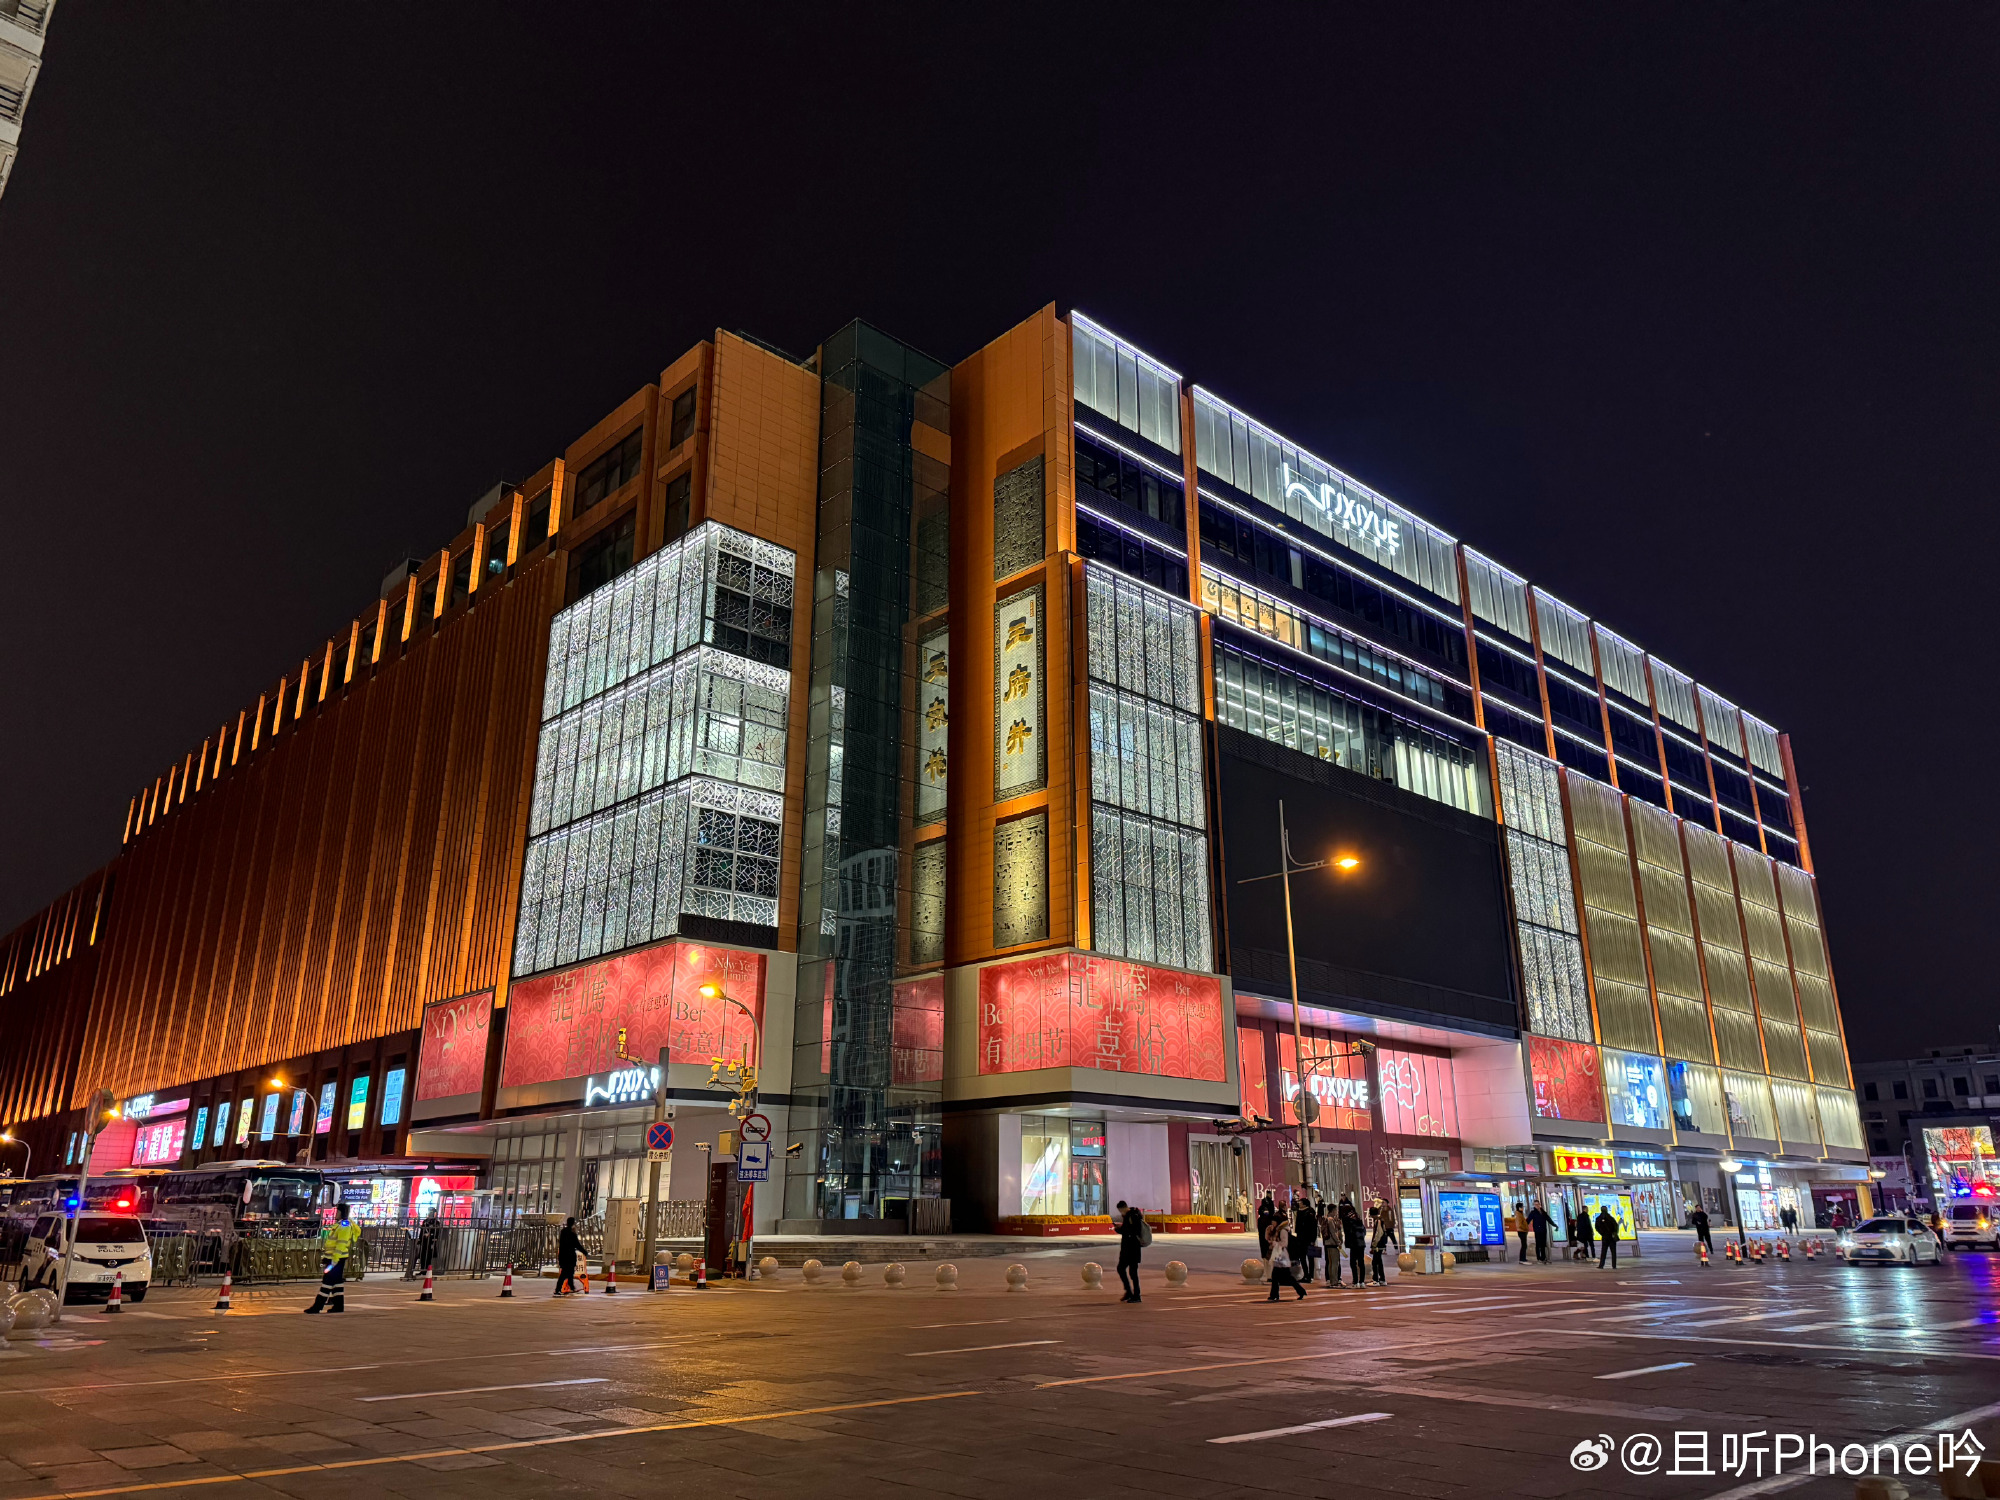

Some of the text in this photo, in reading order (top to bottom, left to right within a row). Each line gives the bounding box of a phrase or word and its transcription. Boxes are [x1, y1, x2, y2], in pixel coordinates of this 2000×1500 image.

[1004, 615, 1034, 755] 王府井
[1175, 981, 1191, 997] Ber
[675, 1001, 706, 1022] Ber
[983, 1002, 1013, 1027] Ber
[984, 1027, 1065, 1066] 有意思节
